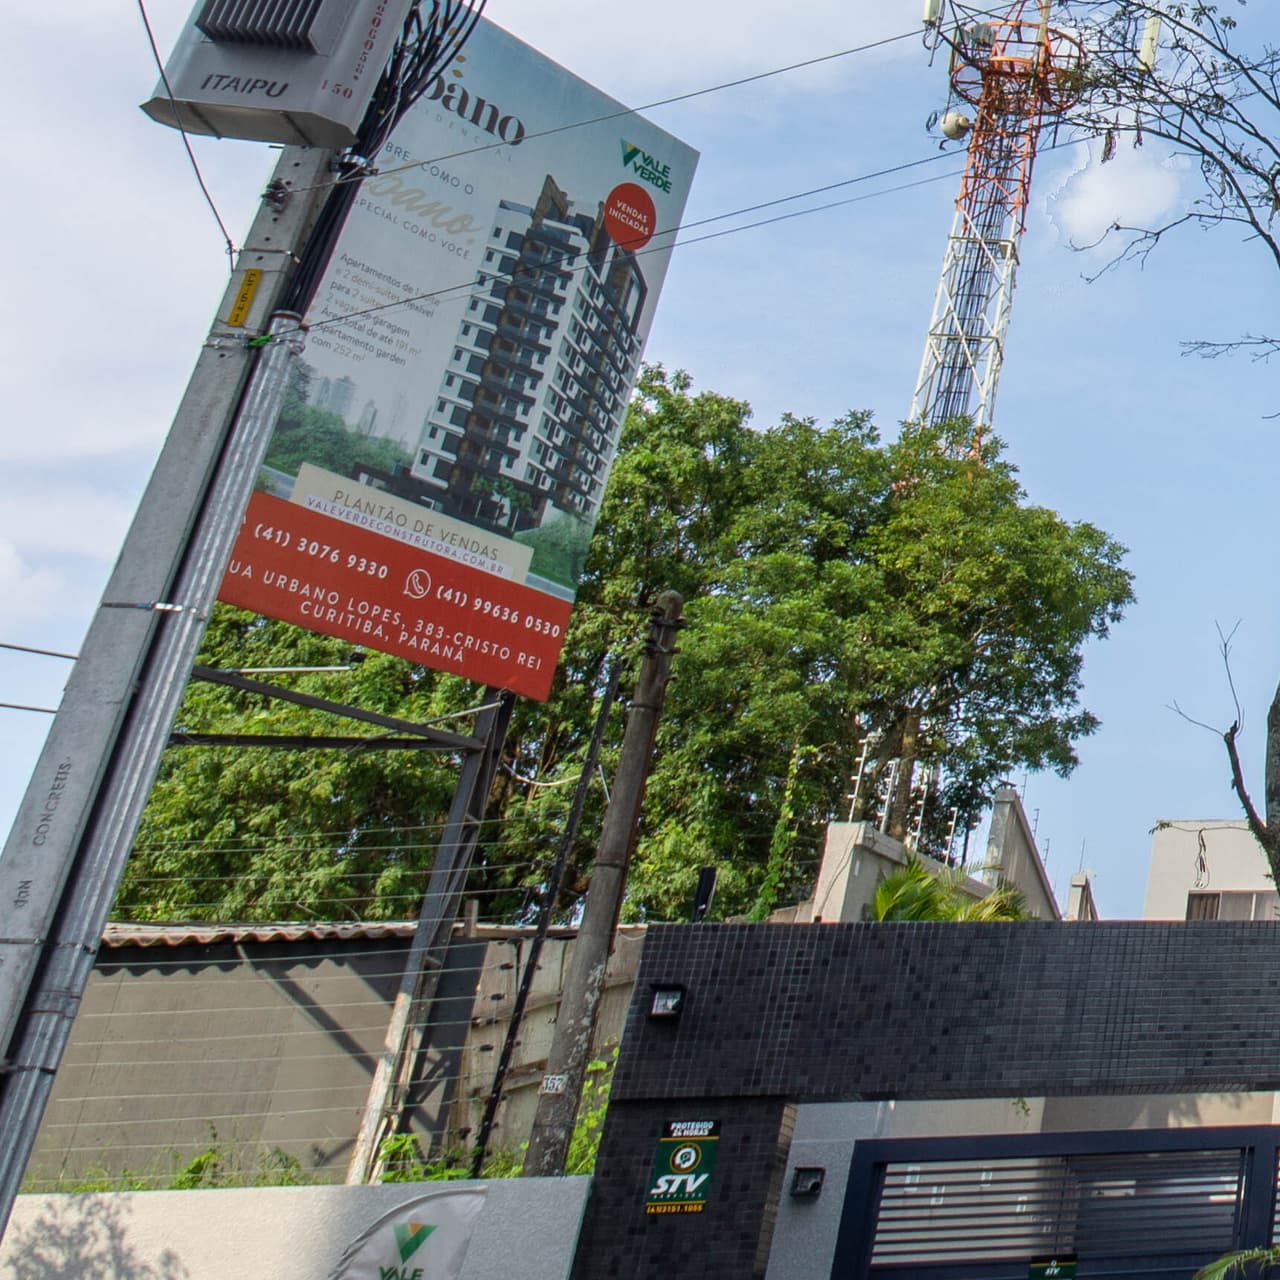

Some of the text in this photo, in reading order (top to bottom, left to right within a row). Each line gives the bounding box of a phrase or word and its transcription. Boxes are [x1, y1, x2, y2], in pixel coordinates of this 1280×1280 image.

[200, 73, 289, 98] ITAIPU
[633, 160, 673, 195] VERDE
[641, 150, 672, 179] VALE
[420, 161, 461, 188] COMO
[464, 183, 474, 196] O
[608, 207, 649, 236] INICIADAS
[617, 200, 648, 224] VENDAS
[402, 220, 437, 242] COMO
[340, 252, 401, 289] Apartamentos
[330, 281, 351, 296] para
[373, 315, 410, 337] garagem
[311, 336, 332, 350] com
[375, 348, 407, 367] garden
[307, 497, 504, 575] VALEVERDECONSTRUTORA.COM.BR
[332, 490, 500, 562] PLANTÃO DE VENDAS
[254, 524, 561, 638] (41) 3076 9330 (41) 99636 0530
[228, 560, 253, 579] UA
[263, 570, 340, 605] URBANO
[348, 597, 406, 630] LOPES,
[517, 651, 542, 670] REI
[300, 601, 465, 663] CURITIBA, PARANÁ
[670, 1121, 714, 1130] PROTEGIDO
[649, 1173, 710, 1194] STV
[379, 1265, 424, 1280] VALE
